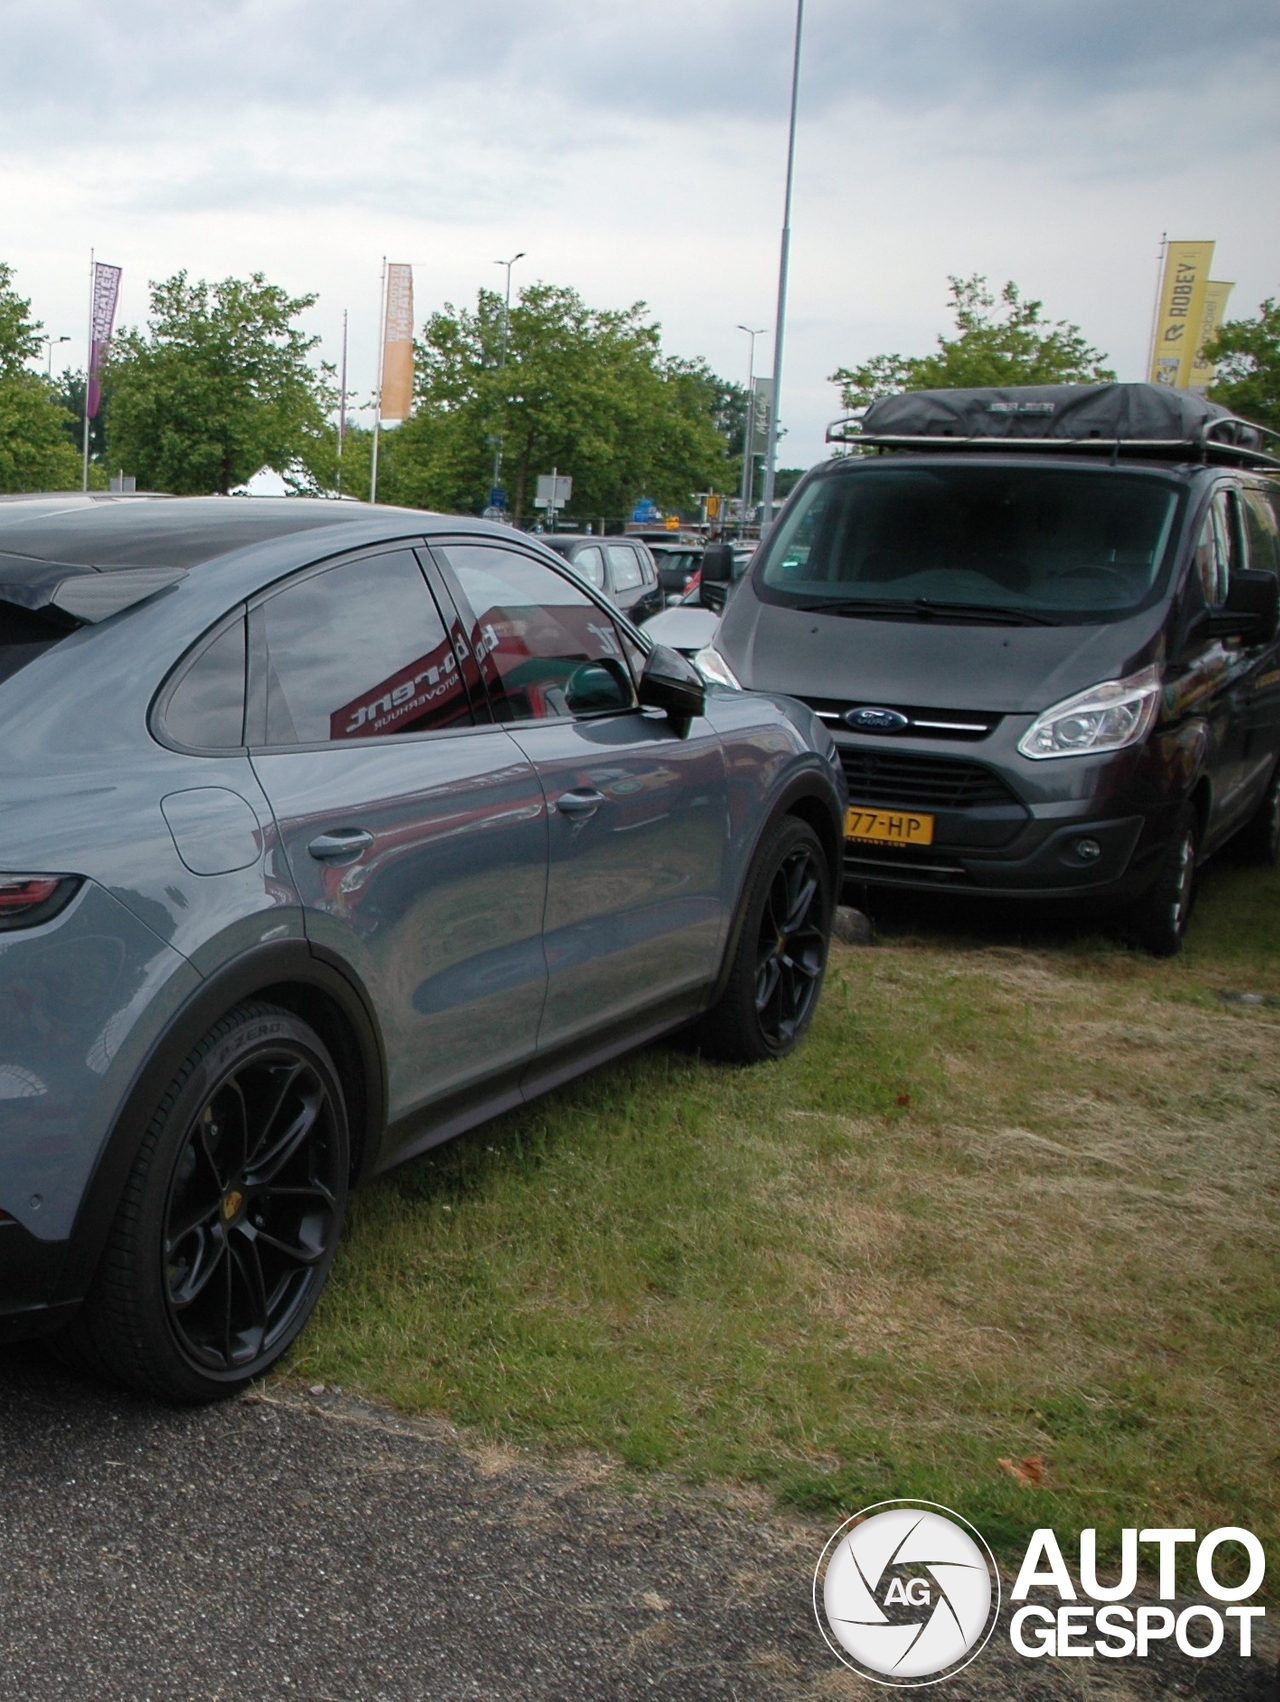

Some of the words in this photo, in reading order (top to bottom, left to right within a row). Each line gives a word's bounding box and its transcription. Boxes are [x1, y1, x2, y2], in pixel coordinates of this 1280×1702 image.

[1169, 263, 1197, 317] ROBEY
[857, 710, 893, 727] Ford
[850, 811, 922, 838] 77-HP
